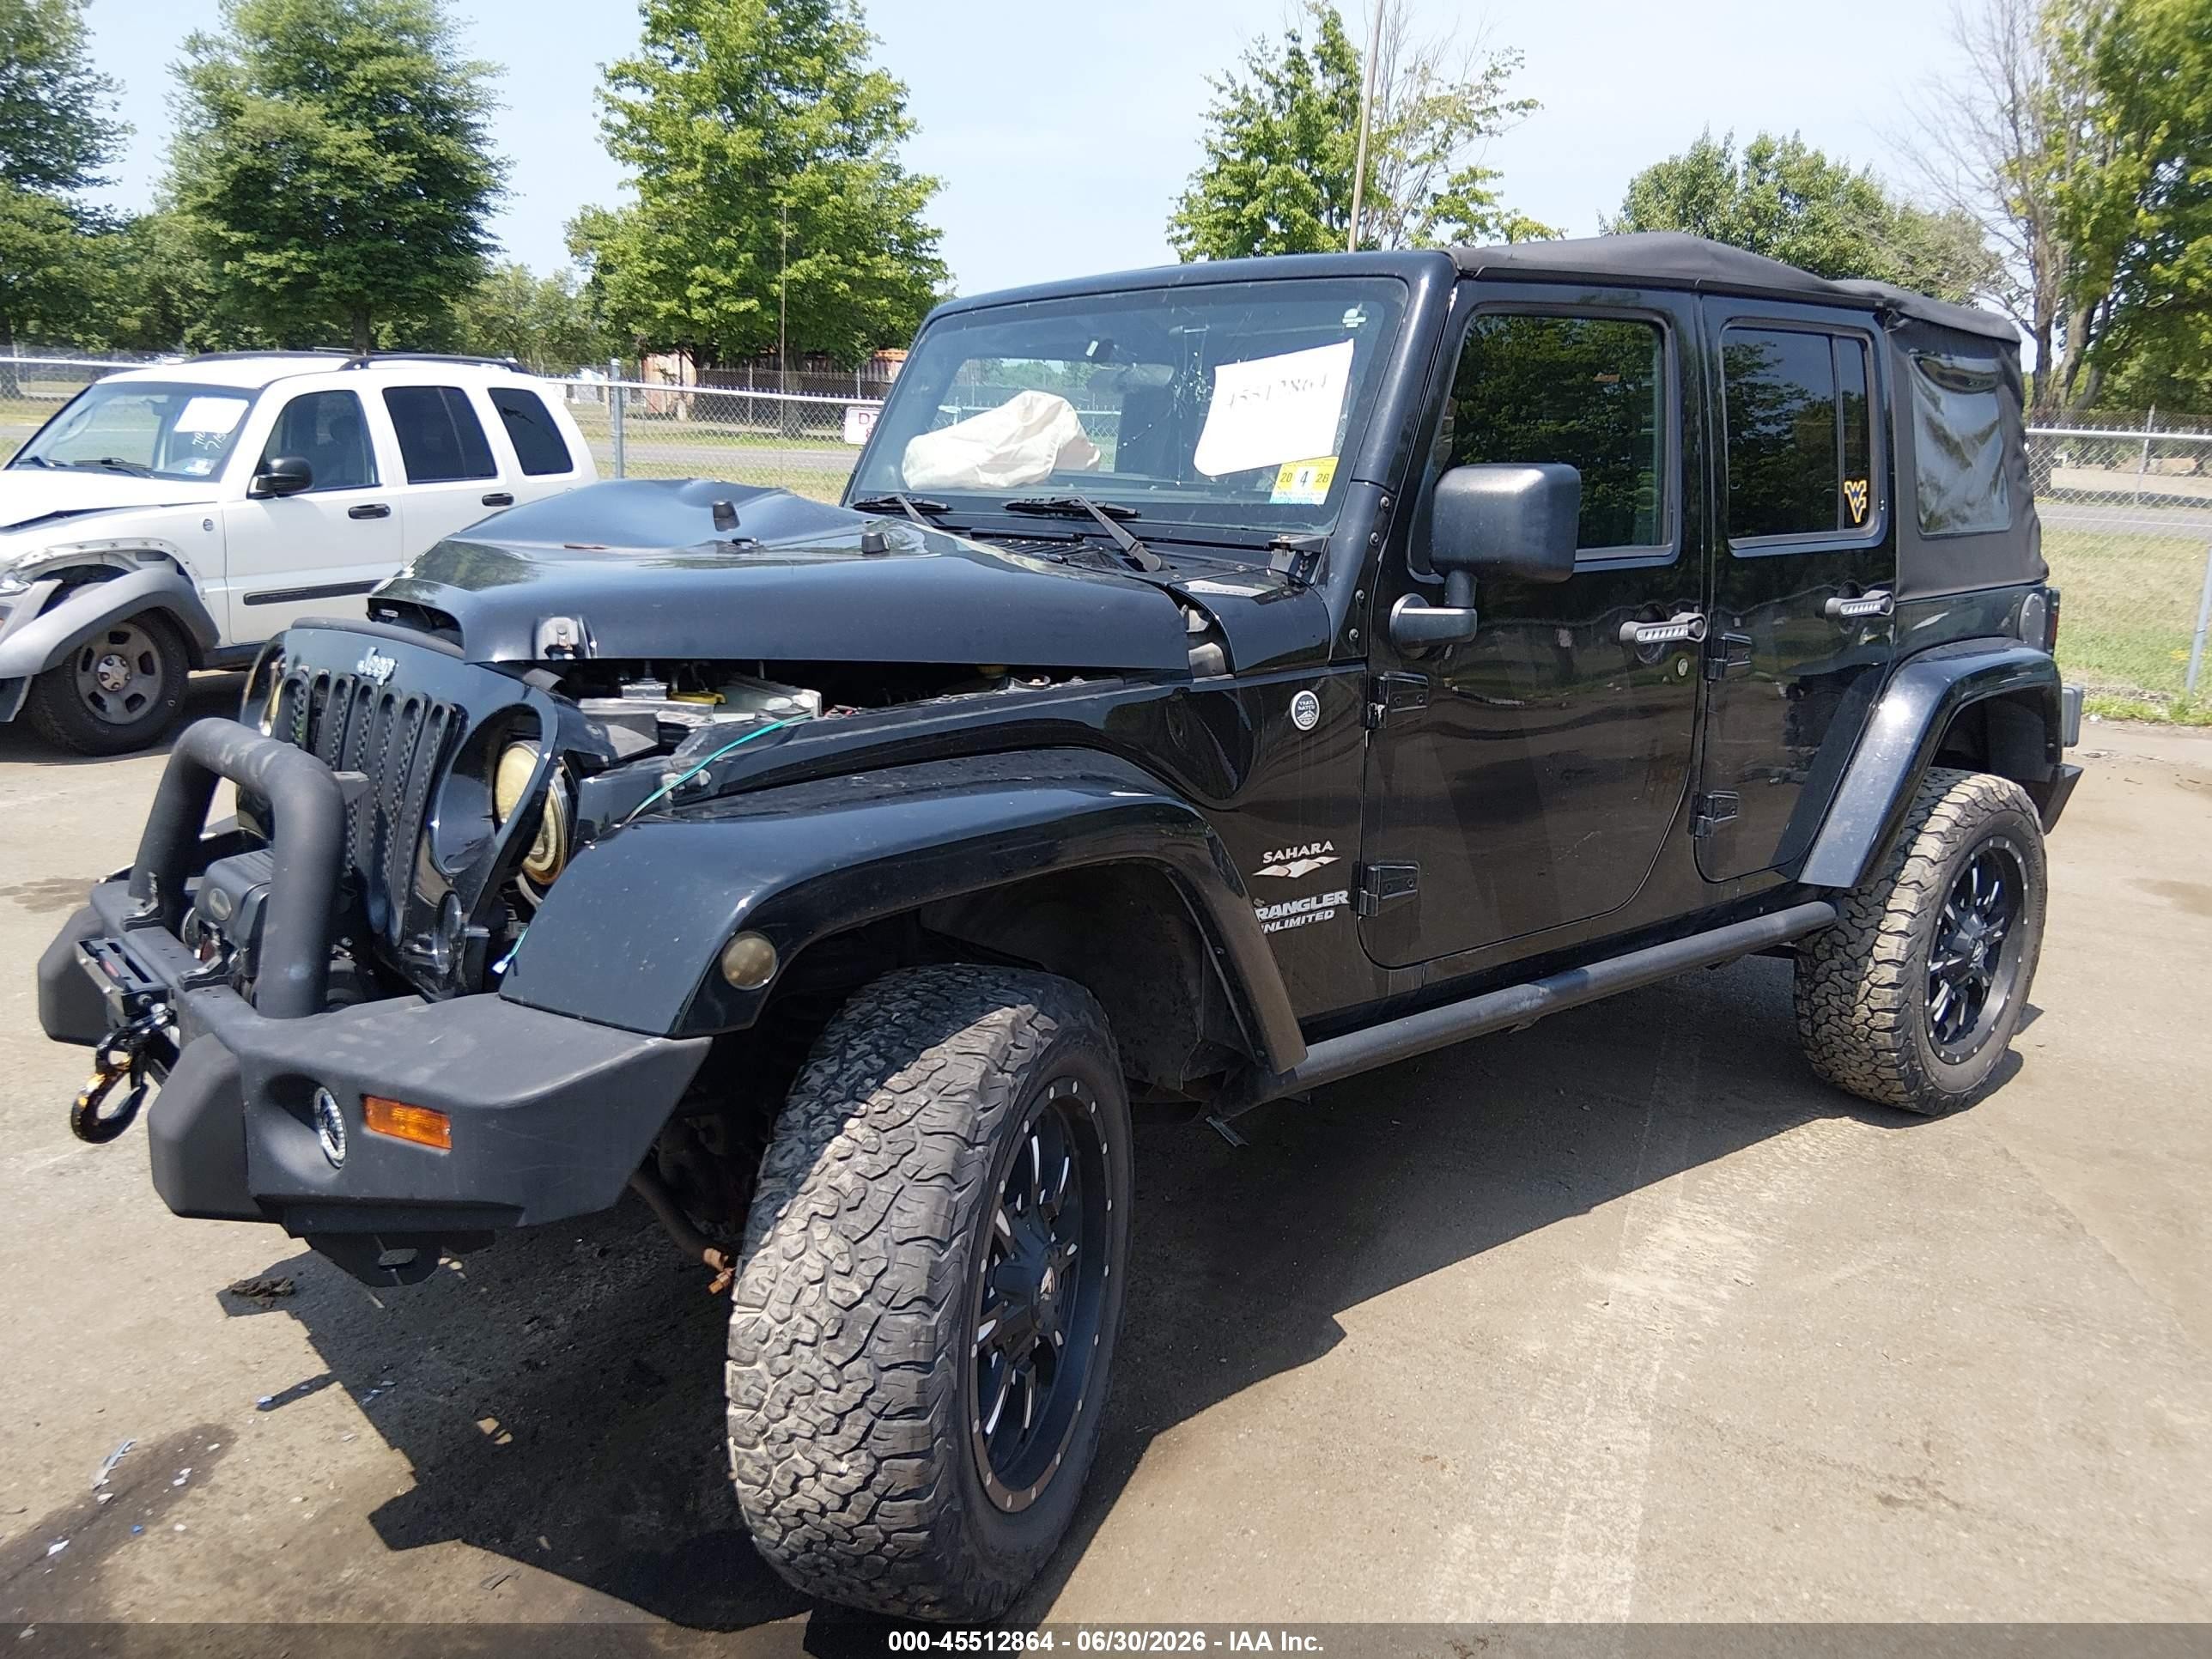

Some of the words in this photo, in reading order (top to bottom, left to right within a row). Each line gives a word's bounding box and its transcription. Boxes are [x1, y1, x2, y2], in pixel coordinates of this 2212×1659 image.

[1279, 472, 1293, 483] 20
[1299, 471, 1309, 487] 4
[357, 647, 396, 686] Jeep
[1262, 840, 1334, 864] SAHARA
[1255, 890, 1350, 921] RANGLER
[1261, 910, 1335, 934] NLIMITED
